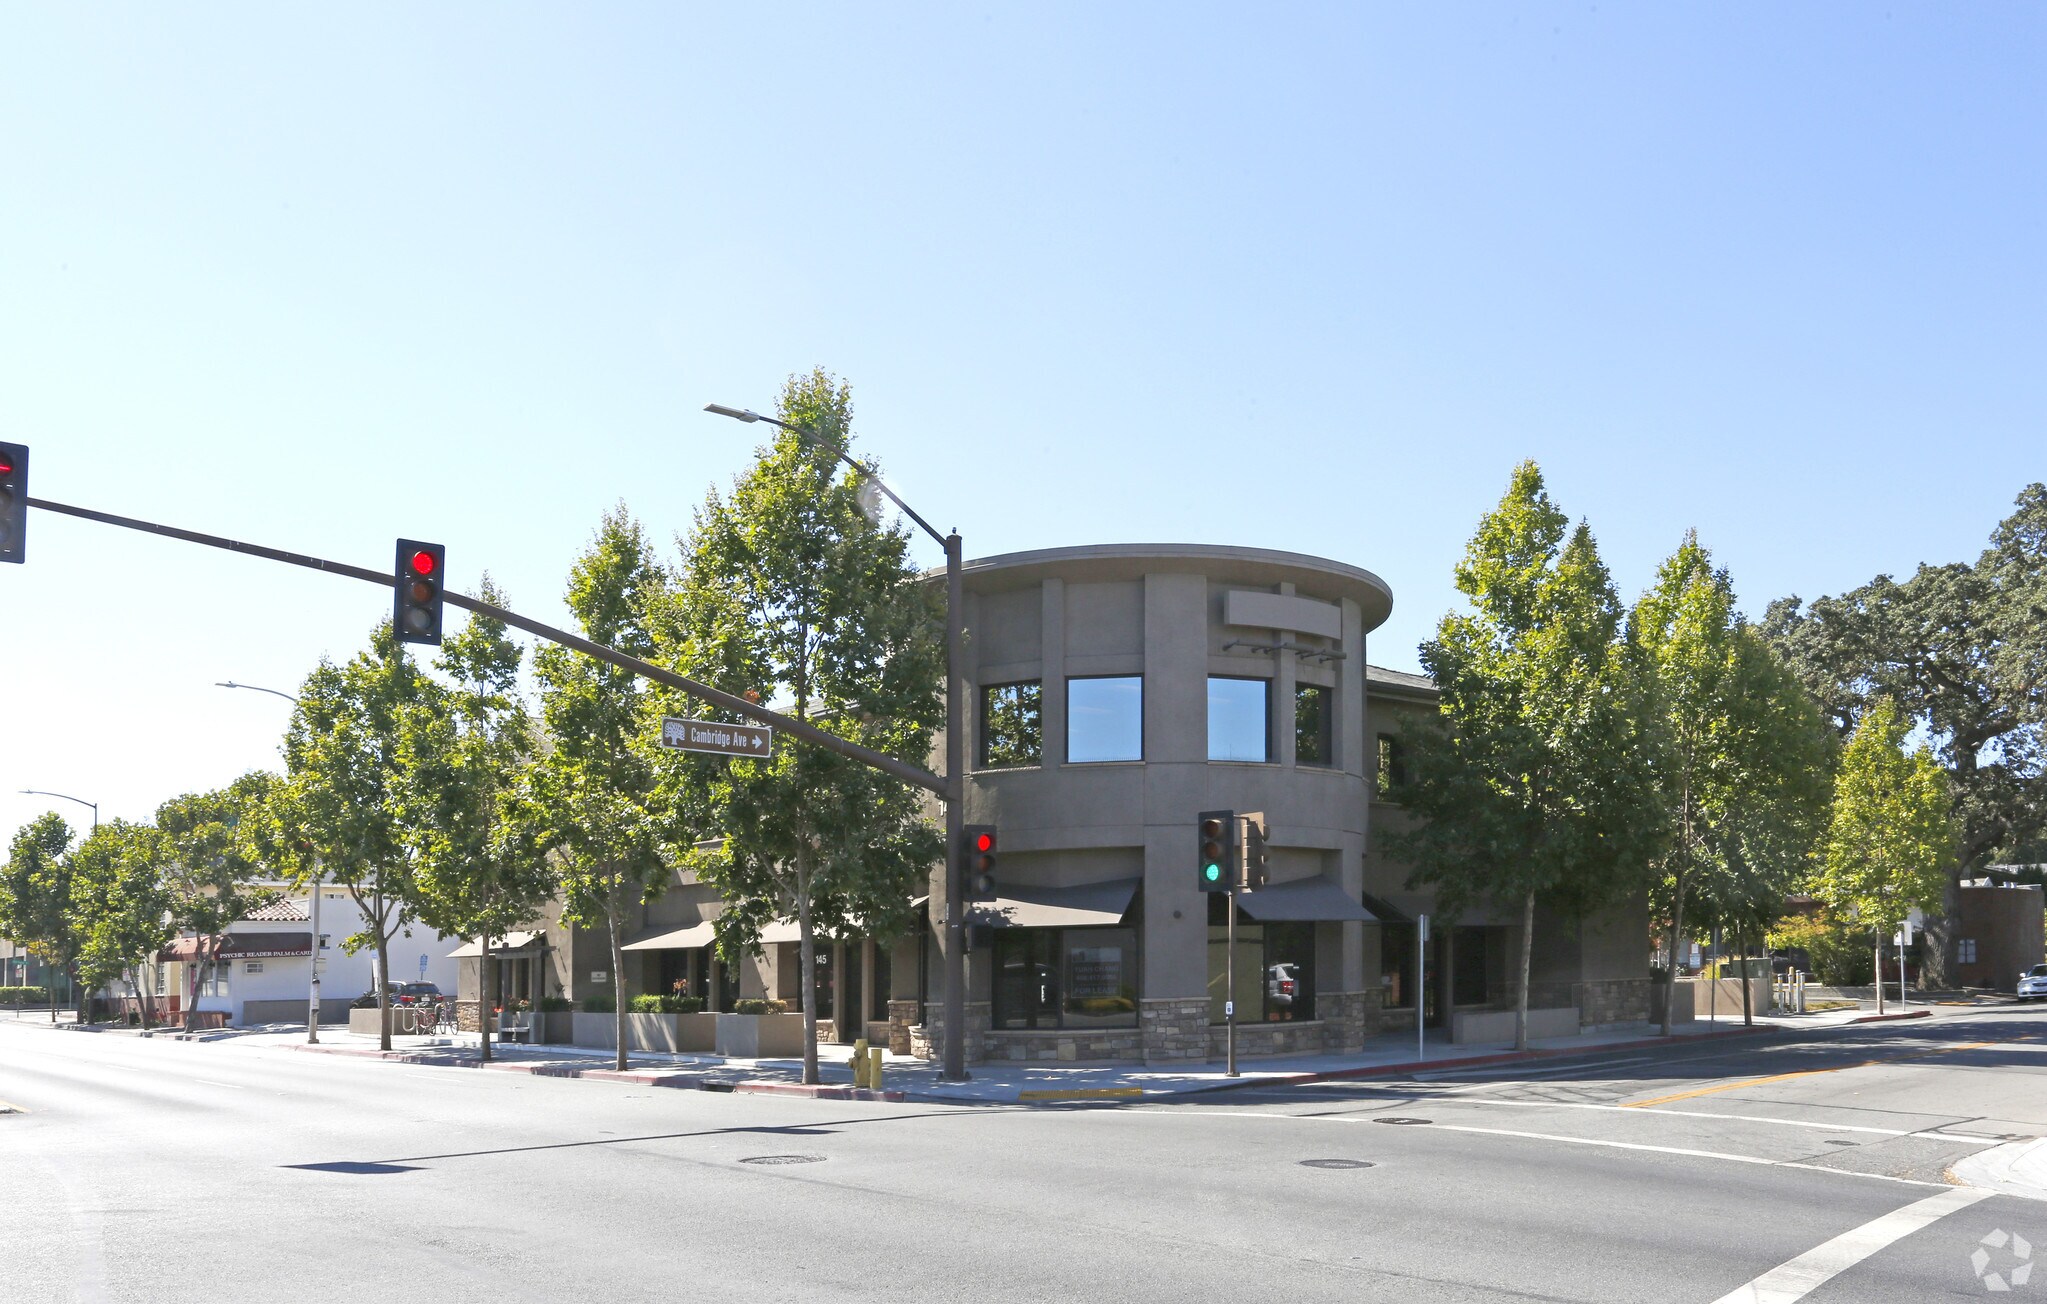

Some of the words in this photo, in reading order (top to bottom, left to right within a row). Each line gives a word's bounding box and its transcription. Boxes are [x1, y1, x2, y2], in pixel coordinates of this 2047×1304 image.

[691, 728, 730, 747] Cambridge
[733, 732, 747, 747] Ave
[816, 955, 826, 964] 145
